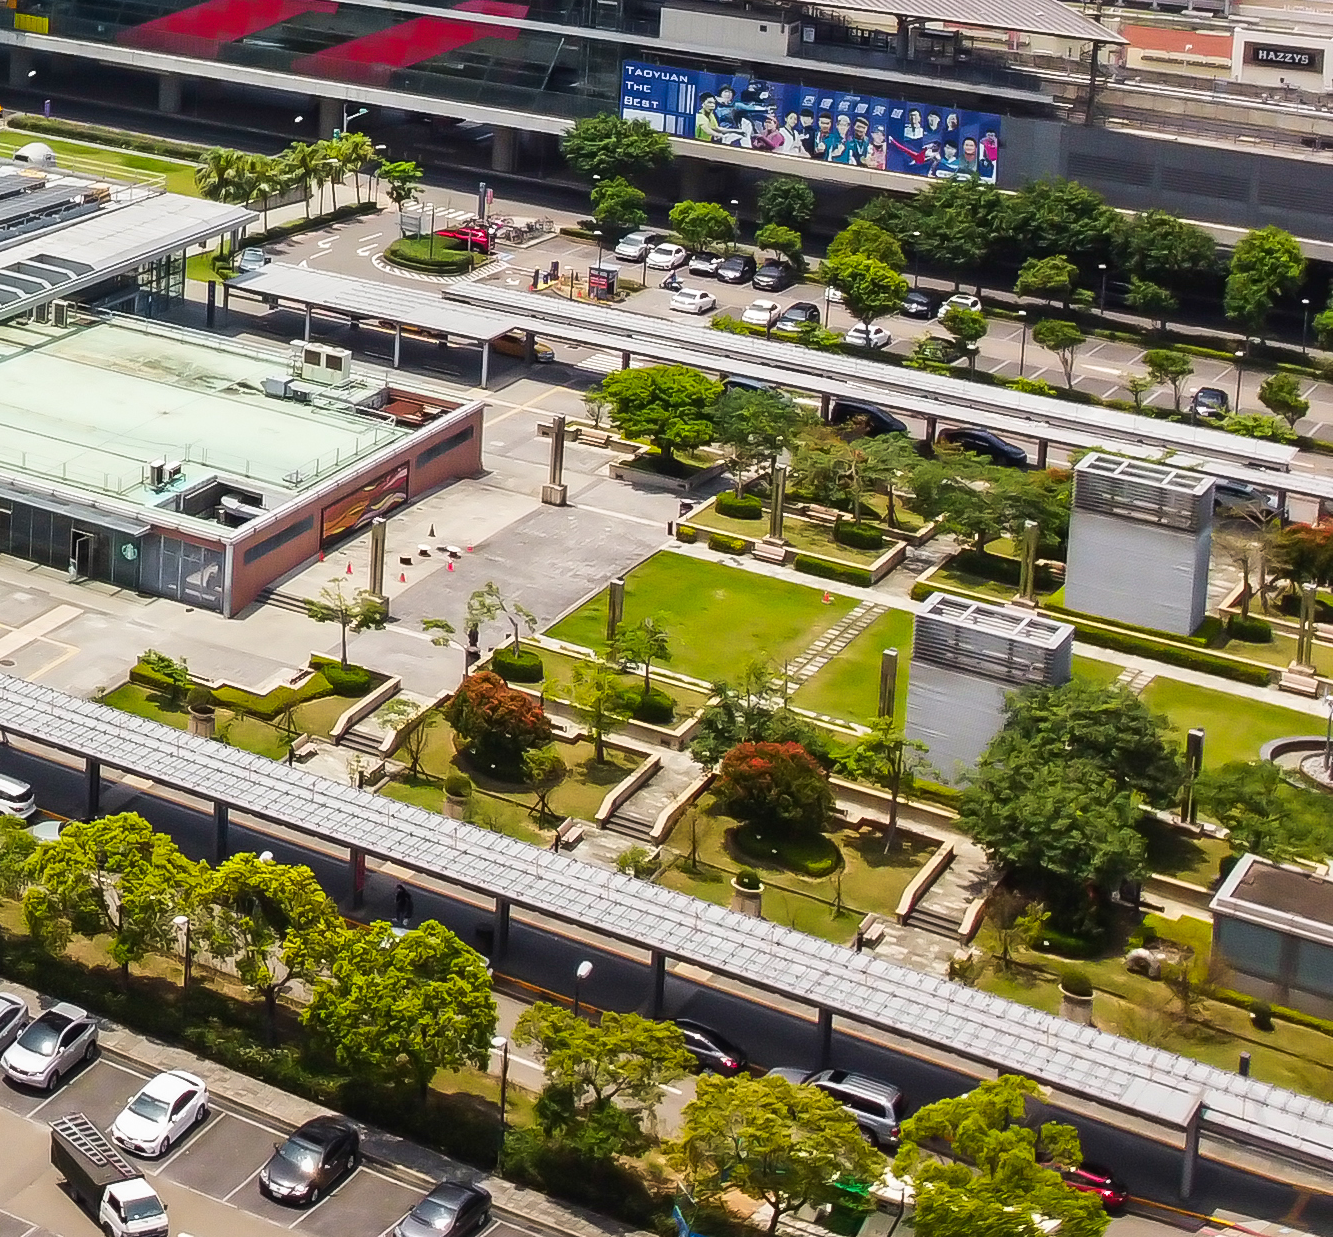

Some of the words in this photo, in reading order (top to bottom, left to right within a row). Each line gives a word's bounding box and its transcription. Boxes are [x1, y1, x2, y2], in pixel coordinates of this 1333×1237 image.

[1258, 49, 1309, 64] HAZZYS
[626, 66, 688, 83] TAOYUAN
[625, 81, 651, 93] THE
[624, 96, 659, 109] BEST
